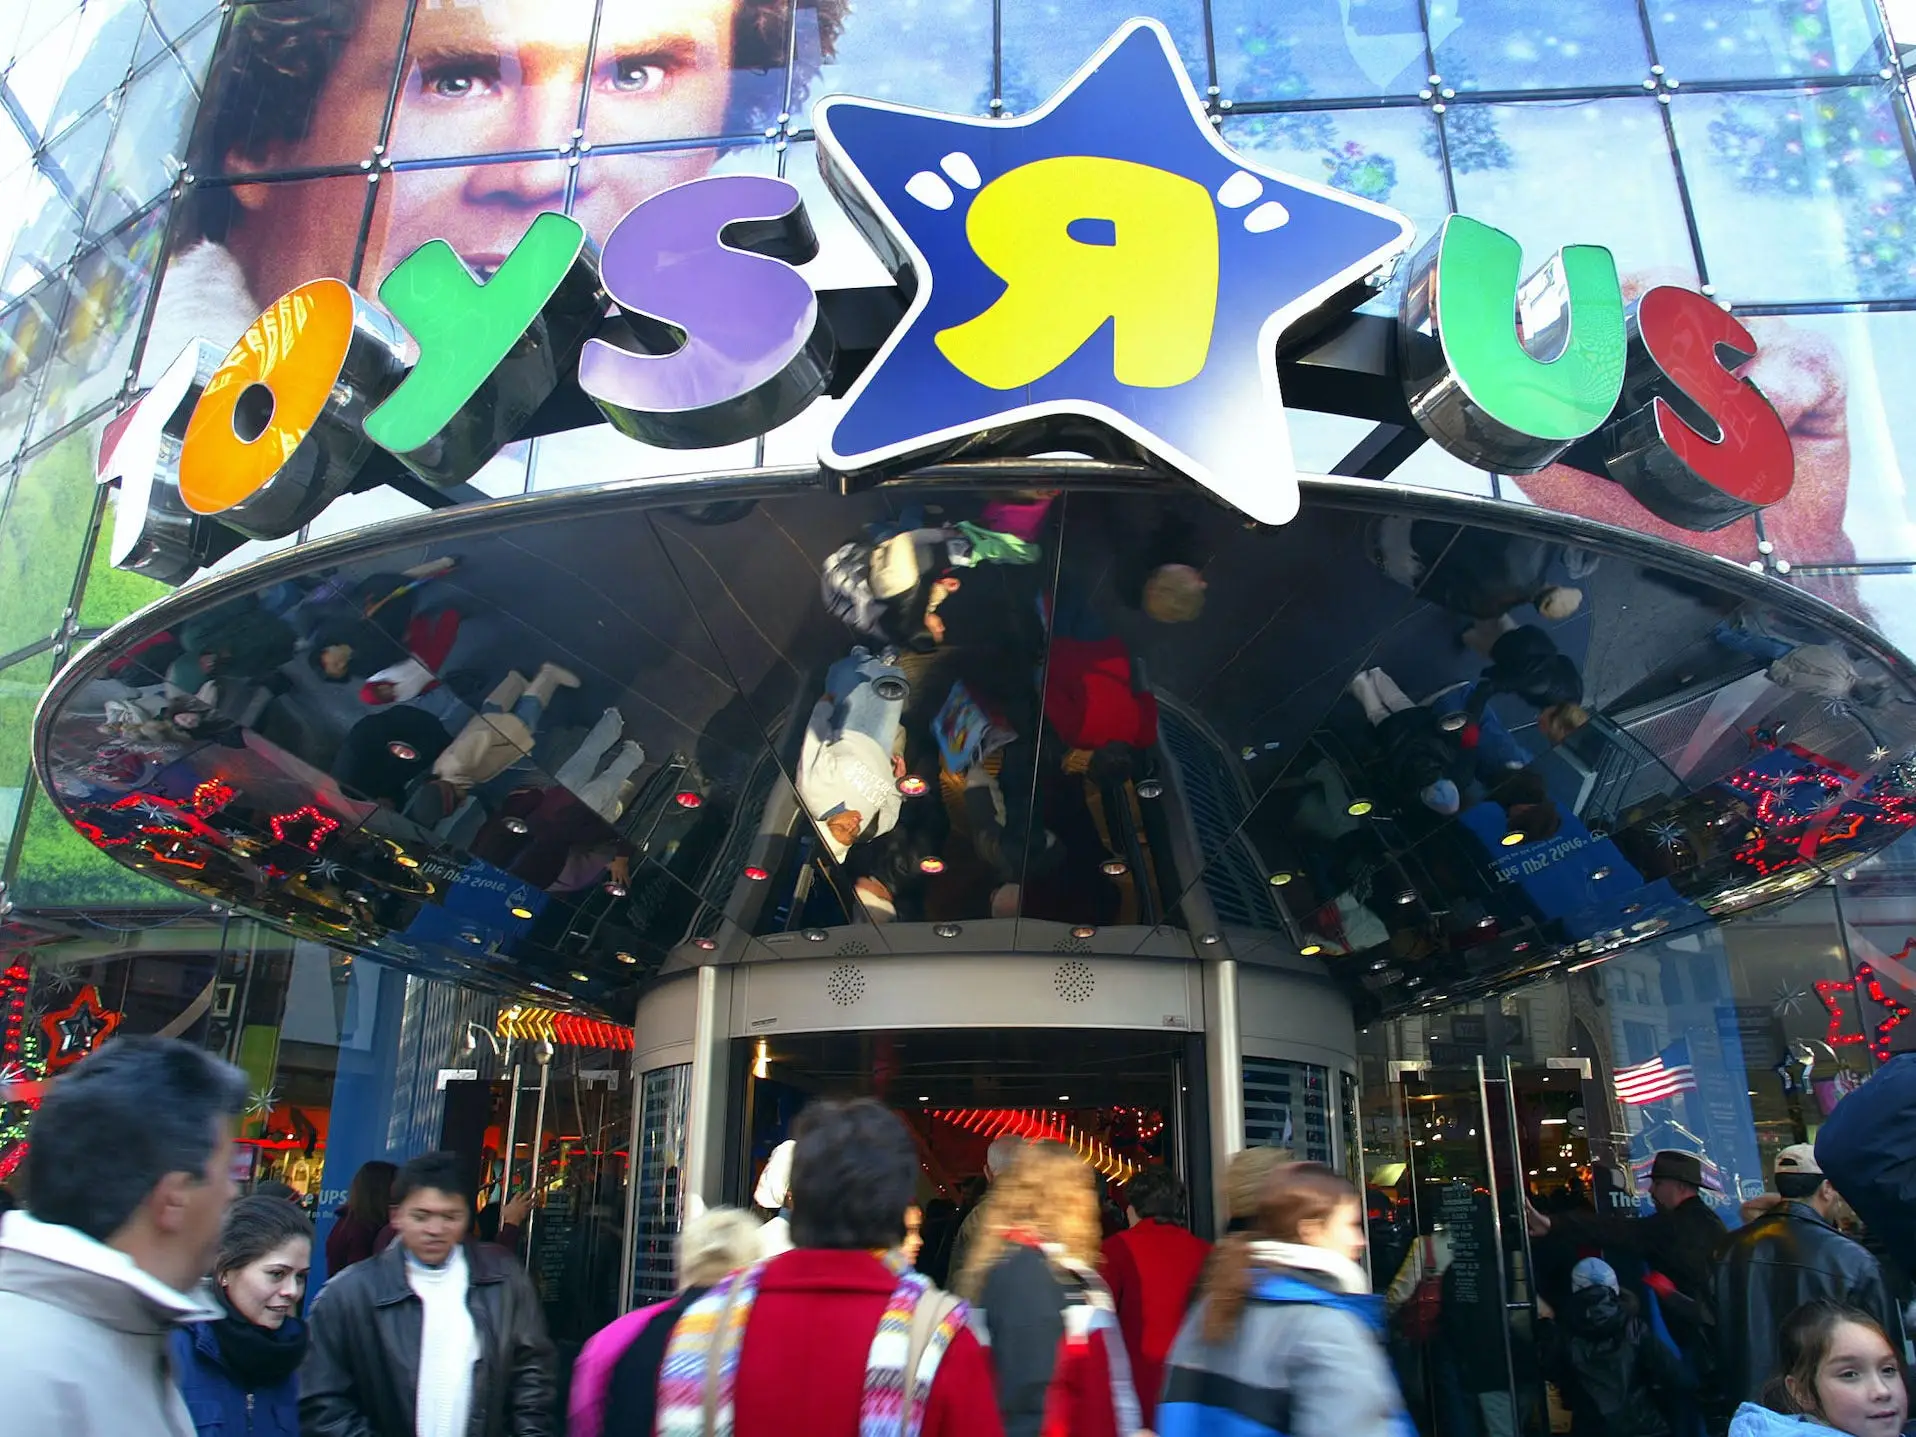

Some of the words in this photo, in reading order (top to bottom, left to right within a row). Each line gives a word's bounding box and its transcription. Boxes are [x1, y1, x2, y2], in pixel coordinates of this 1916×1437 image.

[97, 174, 819, 569] TOYS
[1437, 213, 1796, 506] US
[318, 1189, 348, 1205] UPS
[1609, 1191, 1642, 1209] The
